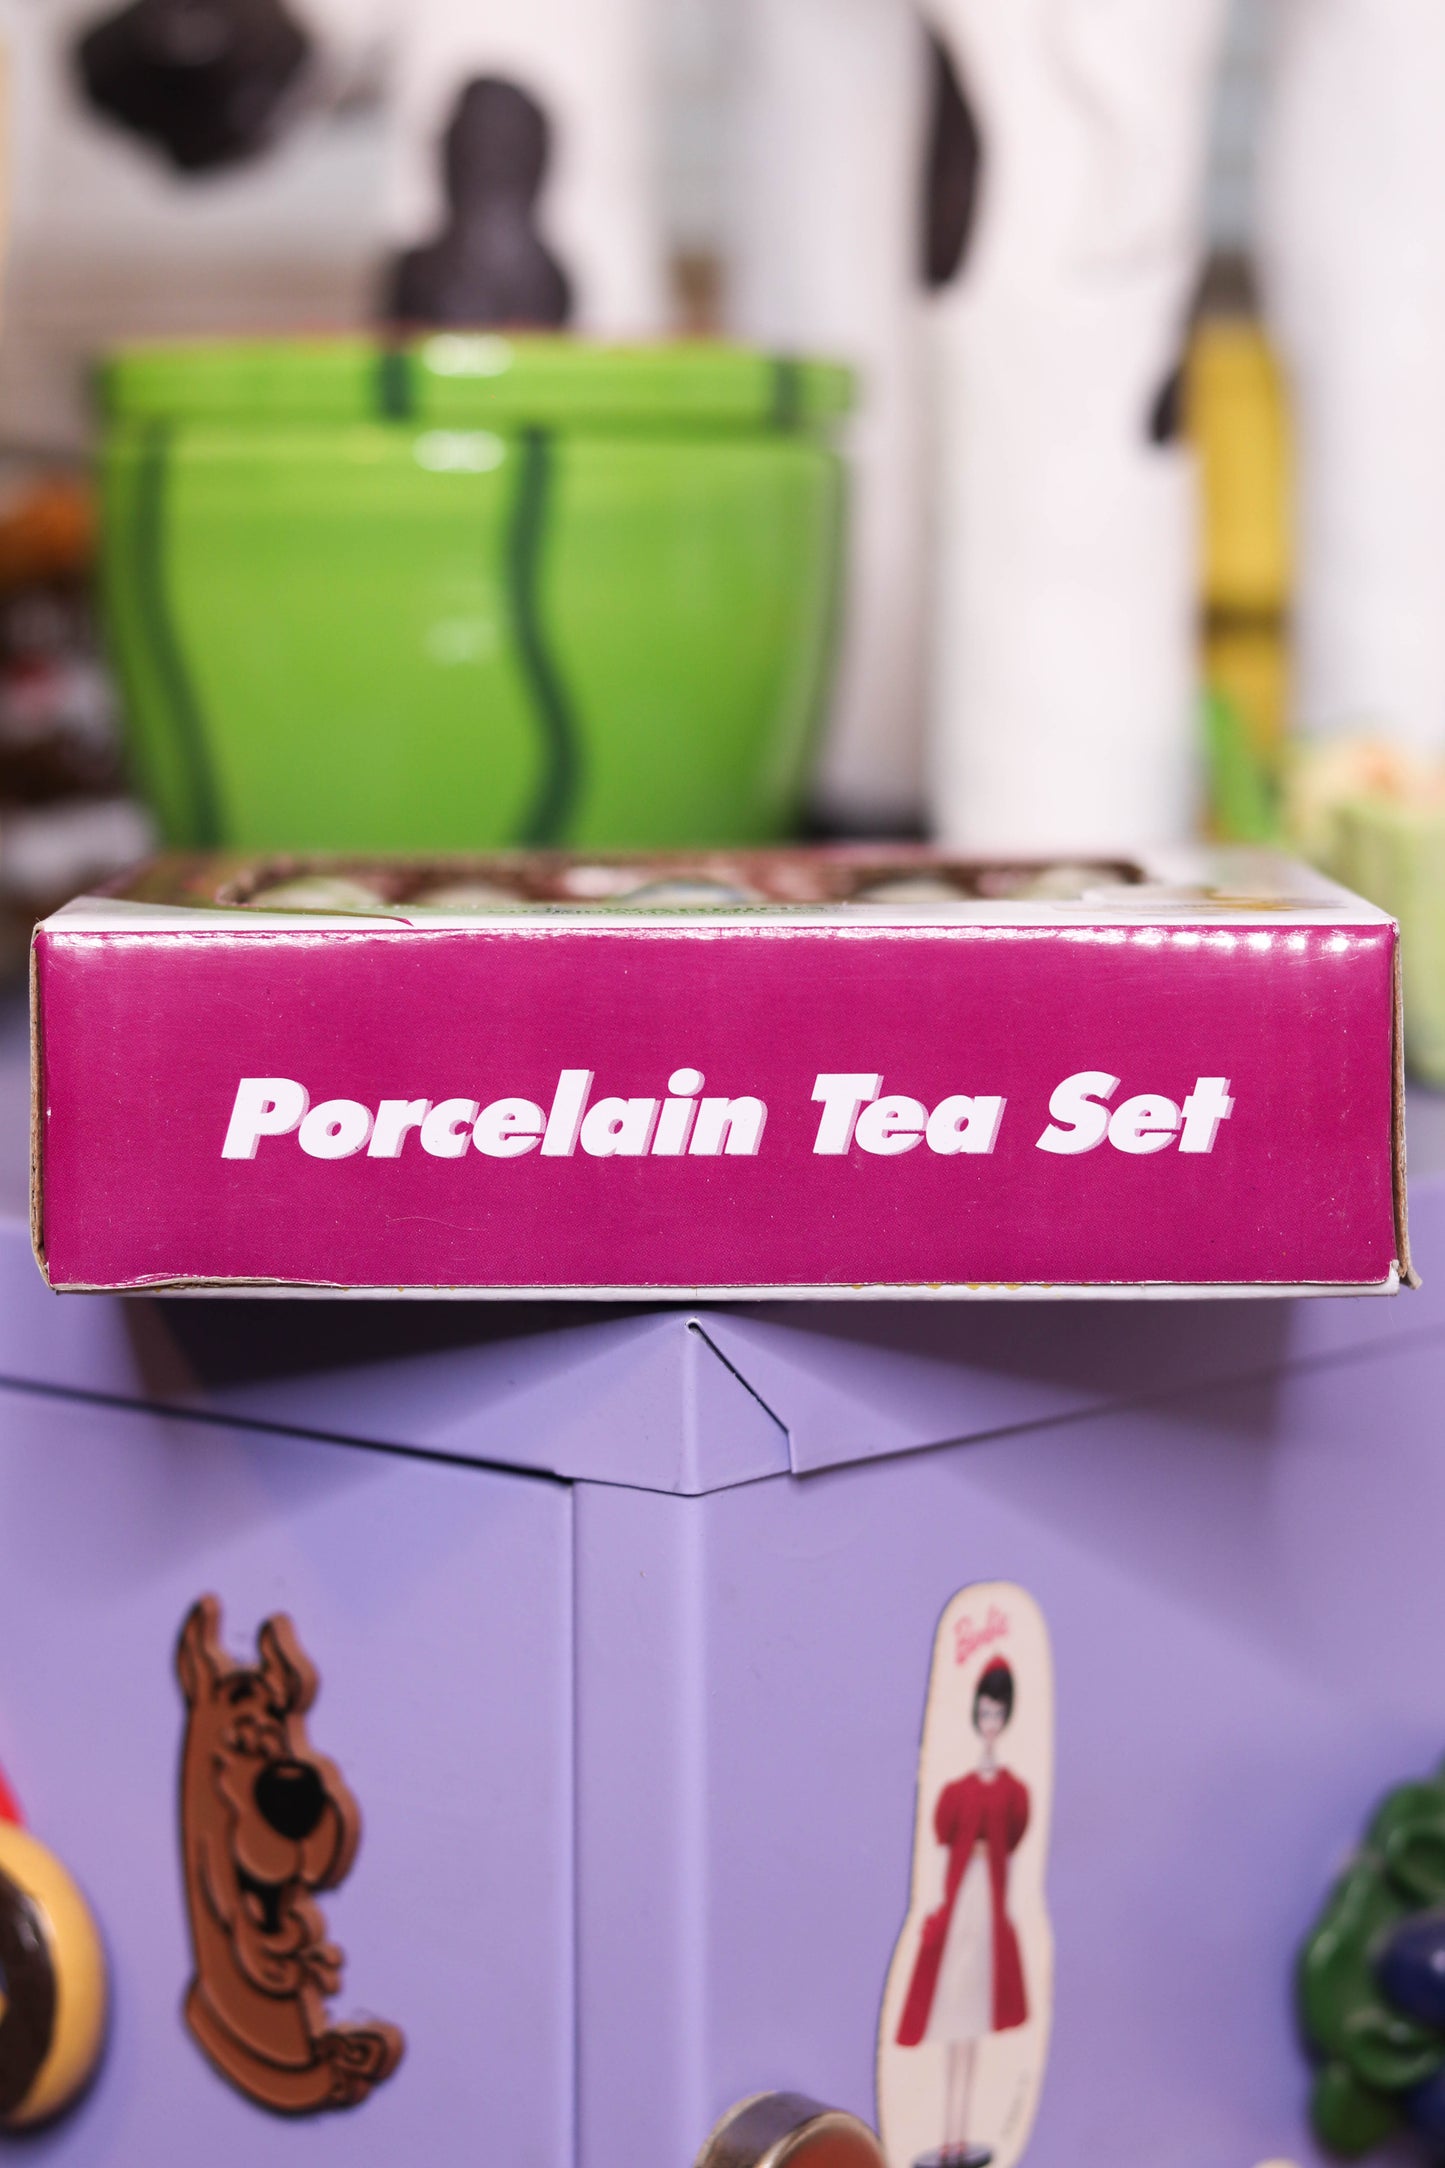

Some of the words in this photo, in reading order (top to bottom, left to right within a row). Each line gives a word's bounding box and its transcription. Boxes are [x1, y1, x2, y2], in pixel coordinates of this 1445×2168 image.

[222, 1068, 768, 1159] Porcelain
[811, 1073, 1006, 1156] Tea
[1036, 1071, 1235, 1155] Set
